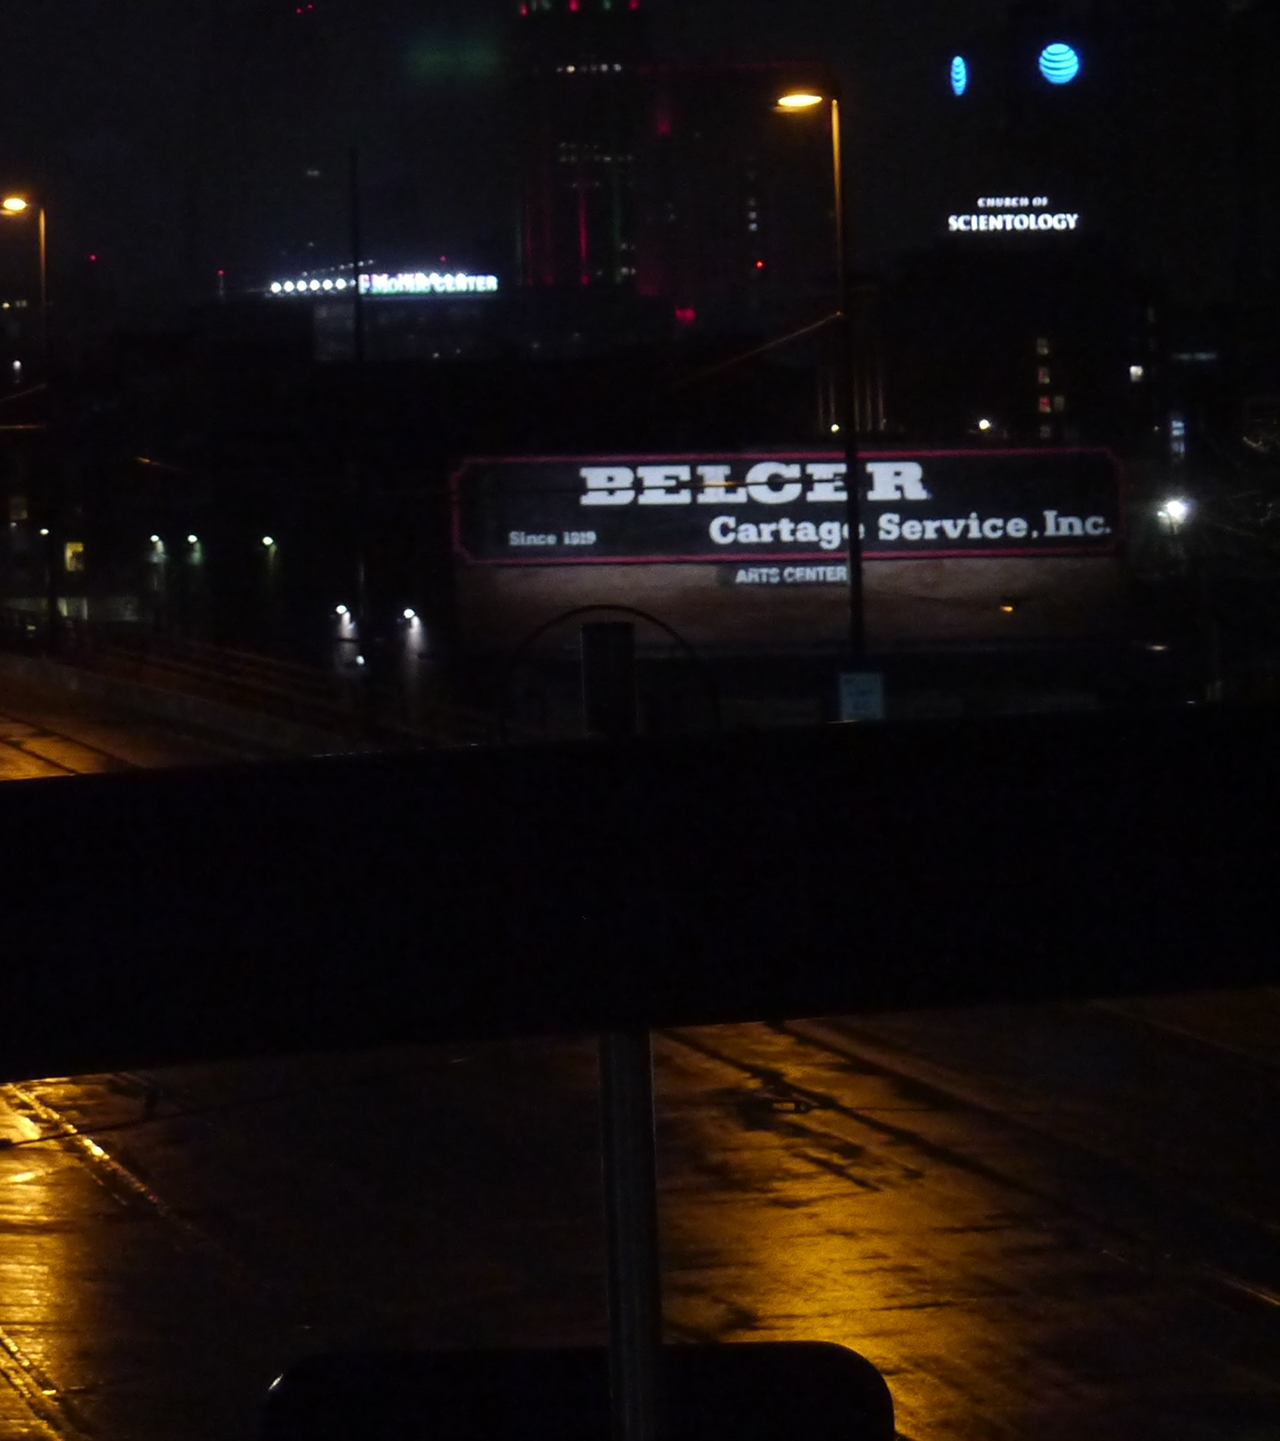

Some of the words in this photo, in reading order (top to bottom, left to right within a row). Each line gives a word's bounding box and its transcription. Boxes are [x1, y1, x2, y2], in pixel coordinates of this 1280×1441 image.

[977, 197, 1029, 208] CHURCH
[1032, 196, 1048, 208] OF
[948, 214, 1078, 232] SCIENTOLOGY
[1041, 510, 1111, 538] Inc.
[509, 531, 557, 545] Since
[734, 567, 779, 584] ARTS
[782, 566, 847, 583] CENTER
